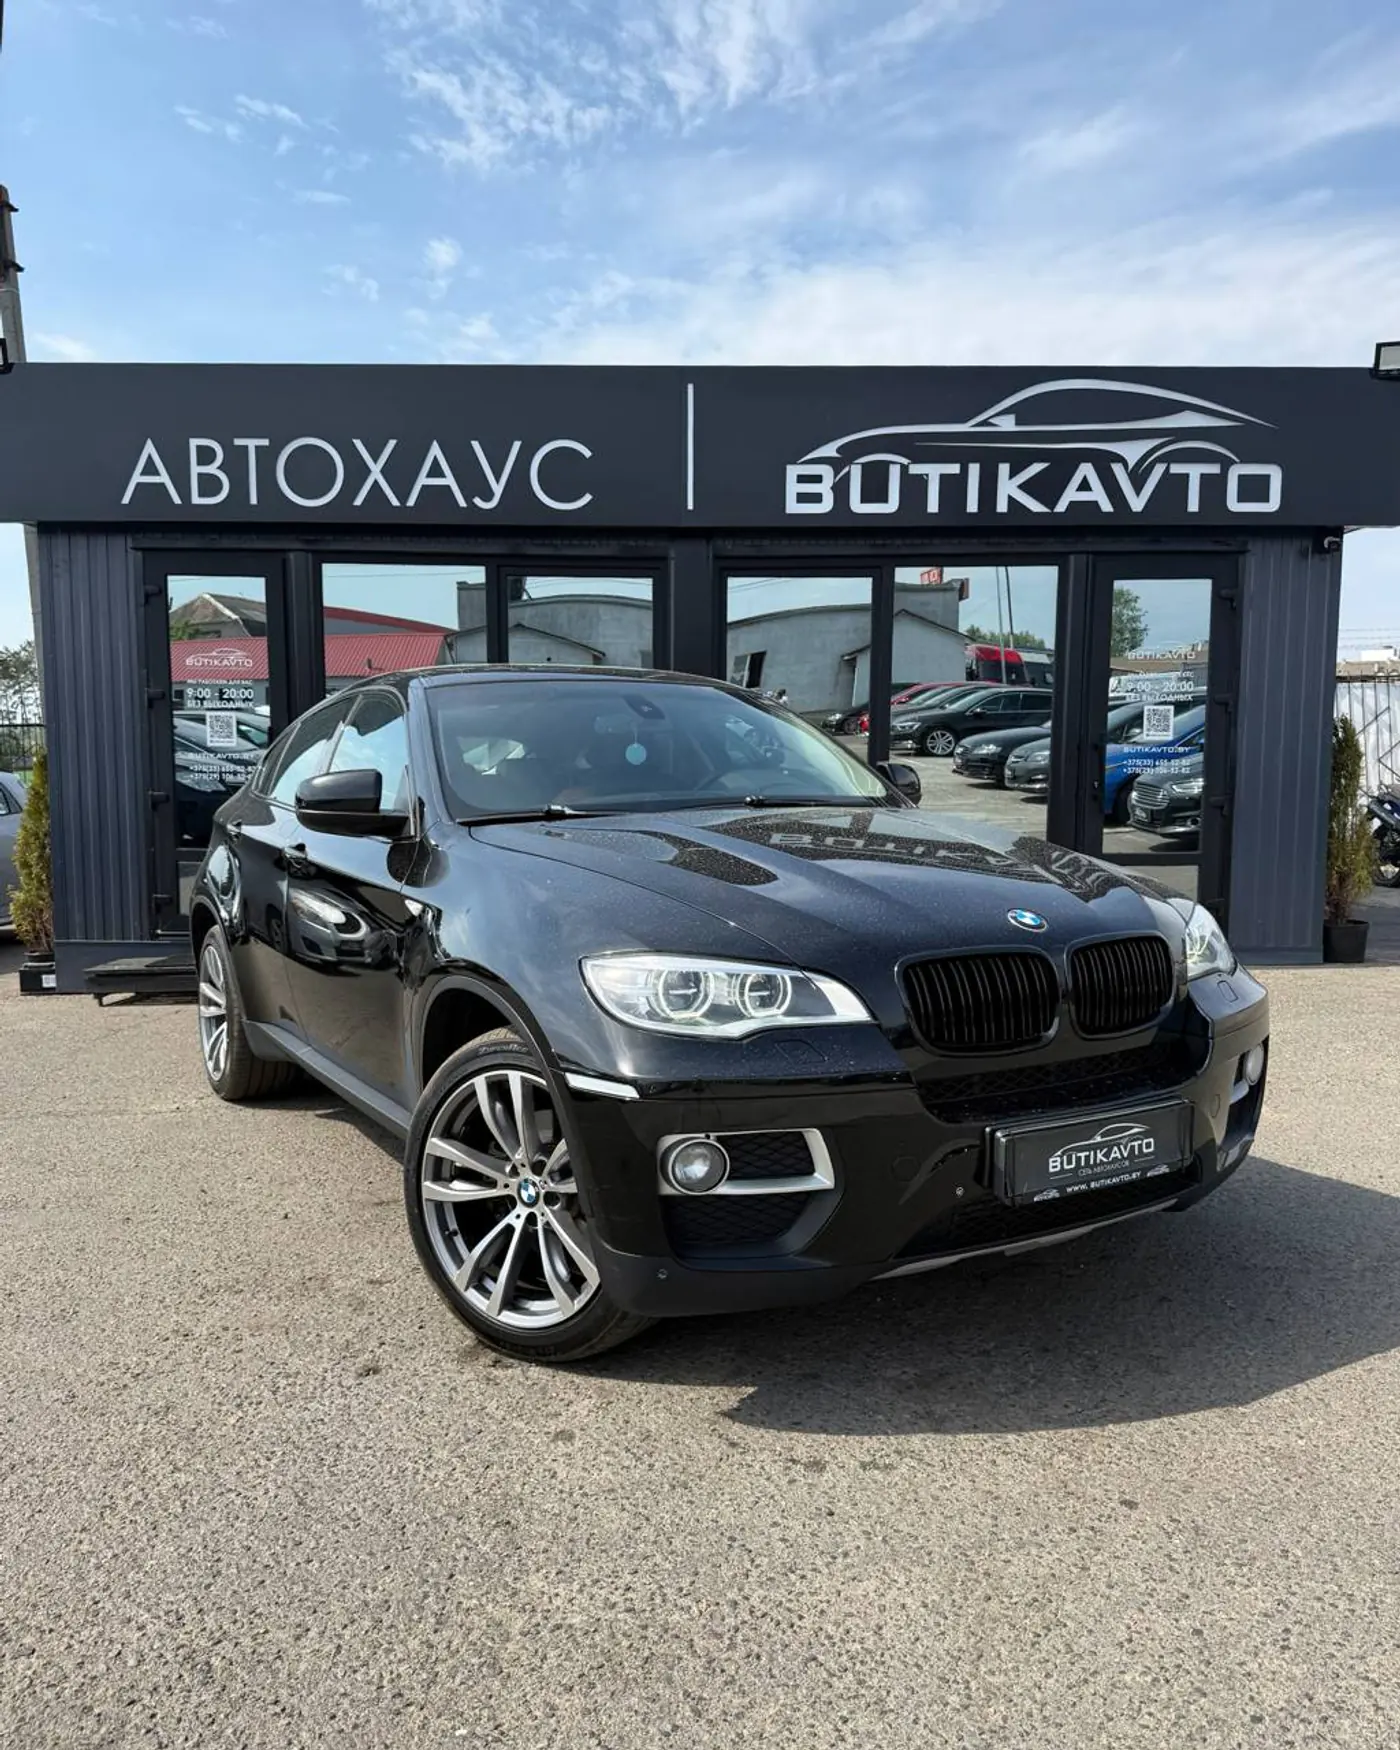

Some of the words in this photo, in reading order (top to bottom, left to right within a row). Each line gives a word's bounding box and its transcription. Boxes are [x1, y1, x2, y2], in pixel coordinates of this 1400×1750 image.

[121, 437, 594, 511] АВТОХАУС
[785, 462, 1283, 515] BUTIKAVTO
[185, 658, 253, 667] BUTIKAVTO
[186, 687, 211, 699] 9:00
[222, 688, 254, 699] 20:00
[1126, 681, 1151, 692] 9:00
[1163, 680, 1194, 692] 20:00
[1048, 1137, 1155, 1173] BUTIKAVTO
